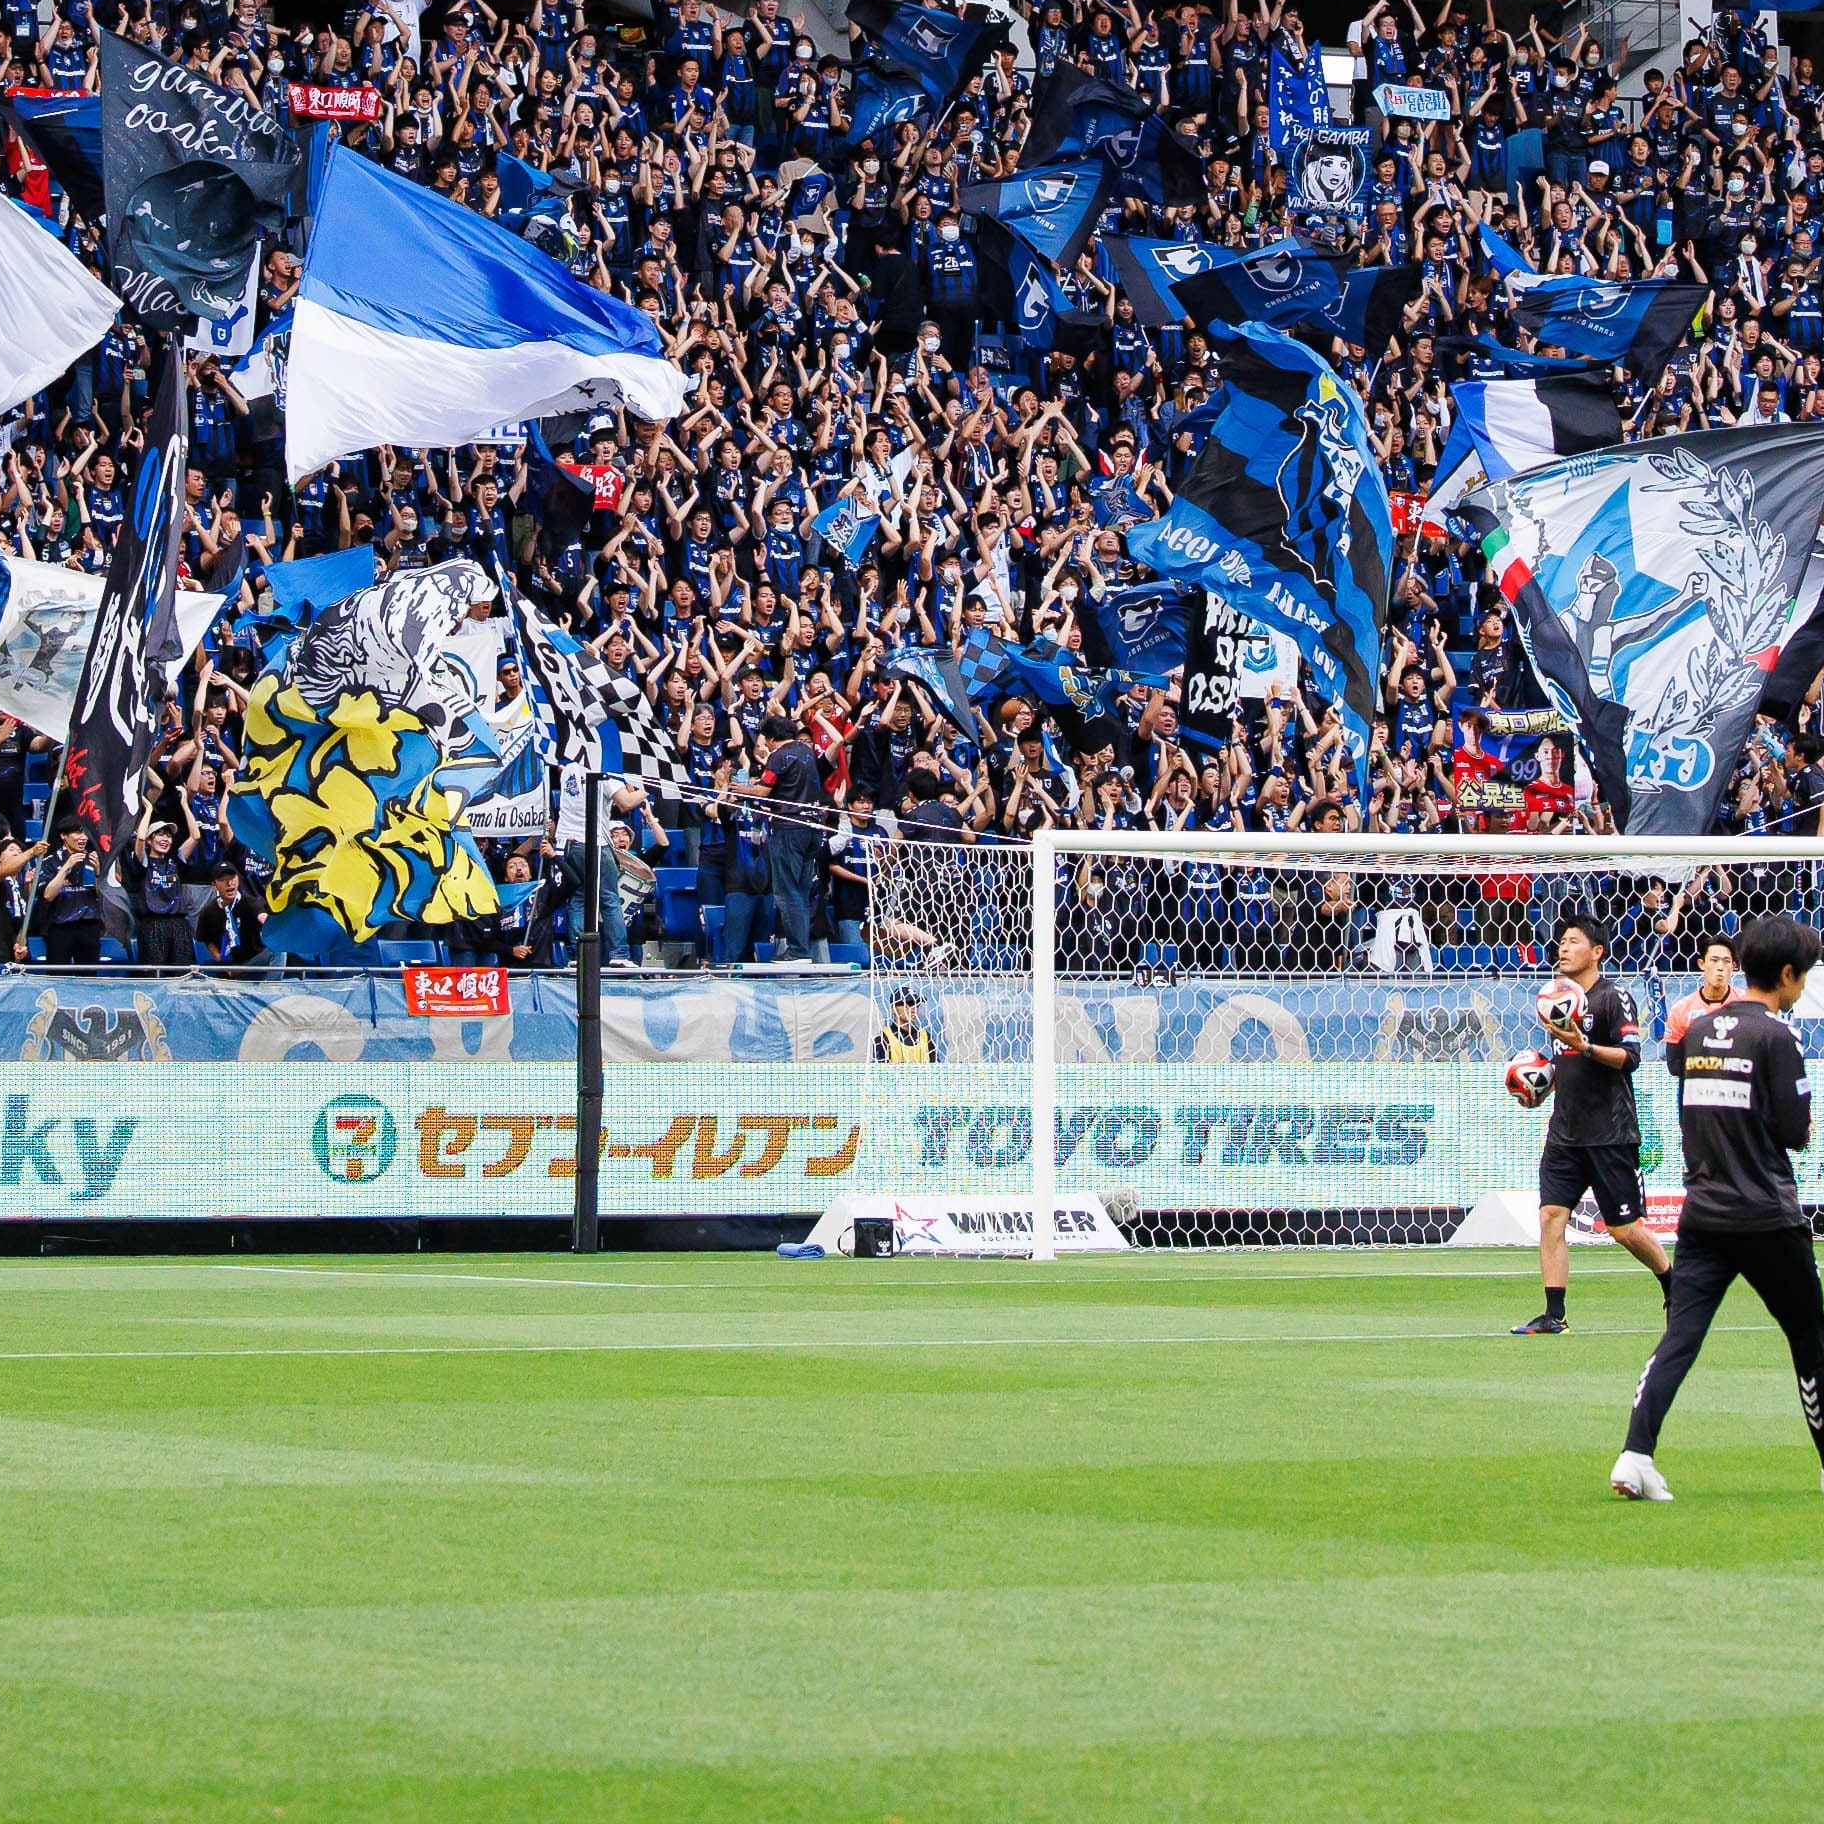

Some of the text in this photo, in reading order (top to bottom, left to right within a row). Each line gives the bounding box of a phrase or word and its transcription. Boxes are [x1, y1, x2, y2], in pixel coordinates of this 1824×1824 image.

[1393, 90, 1447, 110] HIGASHI
[1318, 129, 1371, 147] GAMBA
[1458, 783, 1526, 812] 谷晃生
[412, 970, 501, 1003] 東口順昭
[917, 1103, 1436, 1168] TOYO TIRES
